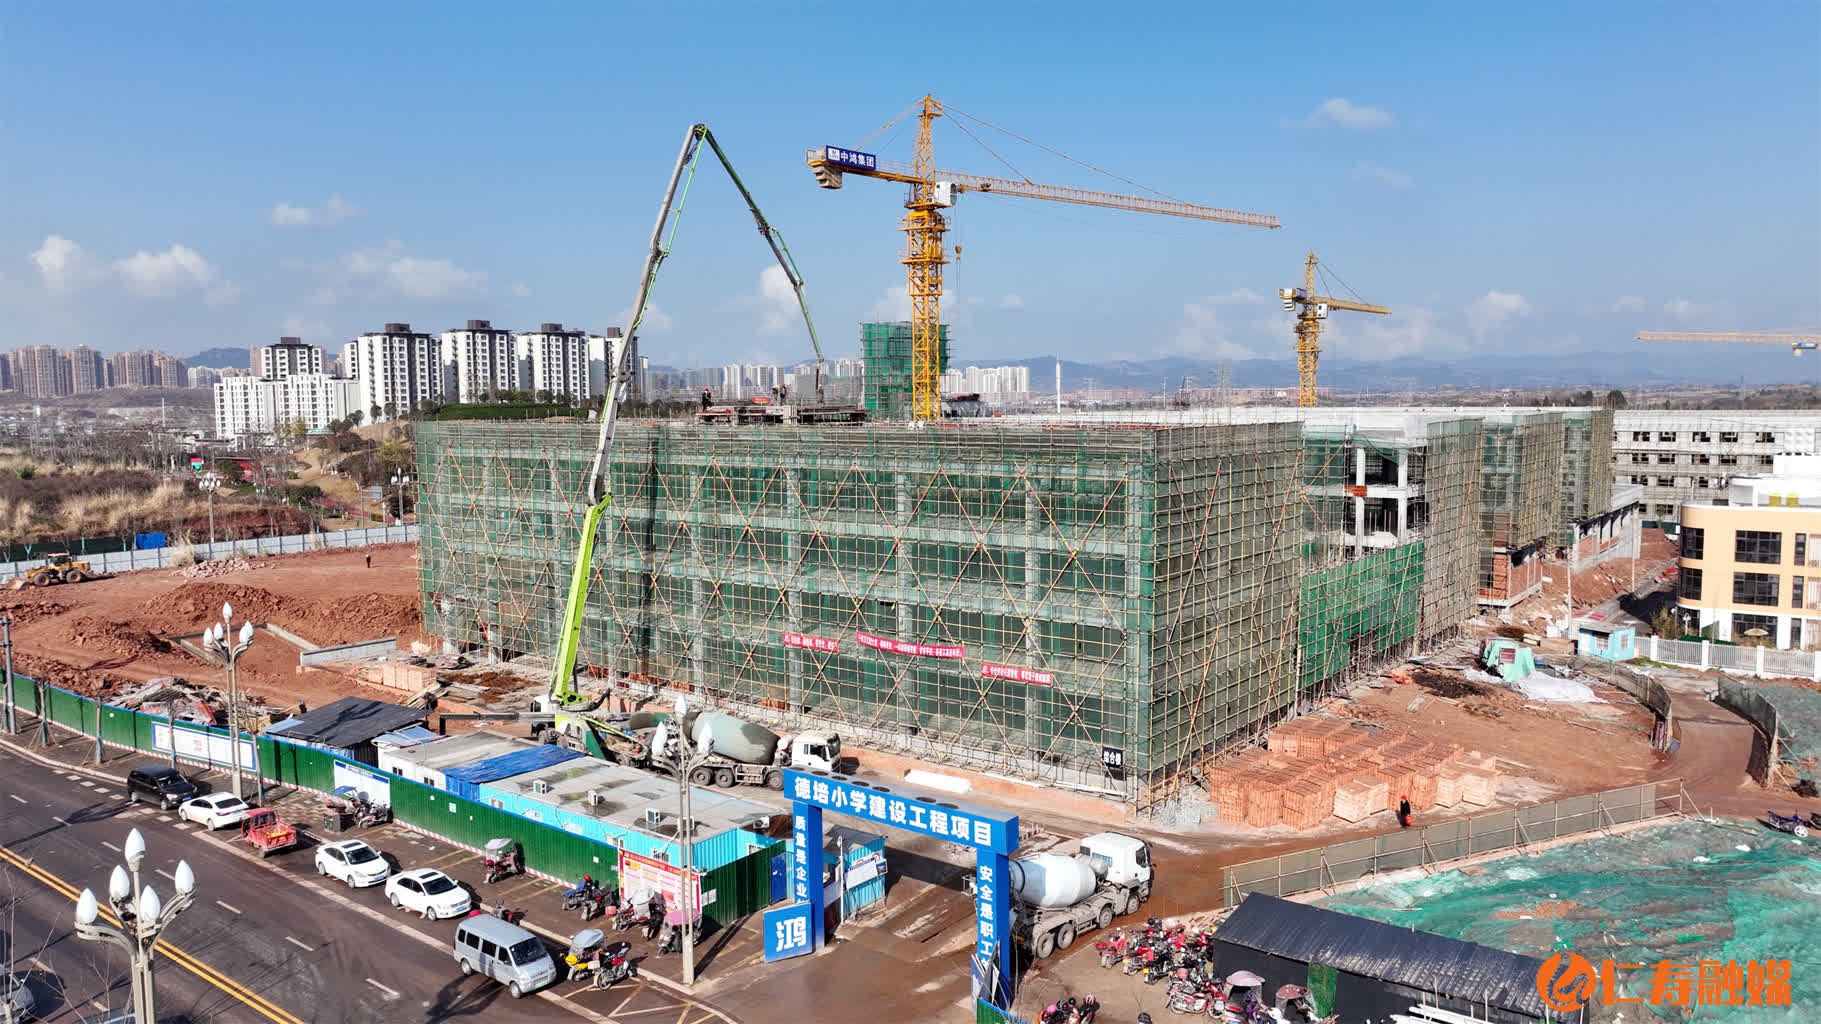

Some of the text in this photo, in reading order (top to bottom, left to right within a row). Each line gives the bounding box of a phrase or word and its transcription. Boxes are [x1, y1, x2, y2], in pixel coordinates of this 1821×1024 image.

[840, 151, 874, 167] 中鸿集团
[794, 776, 992, 847] 德培小学建设工程项目
[775, 916, 807, 952] 鸿
